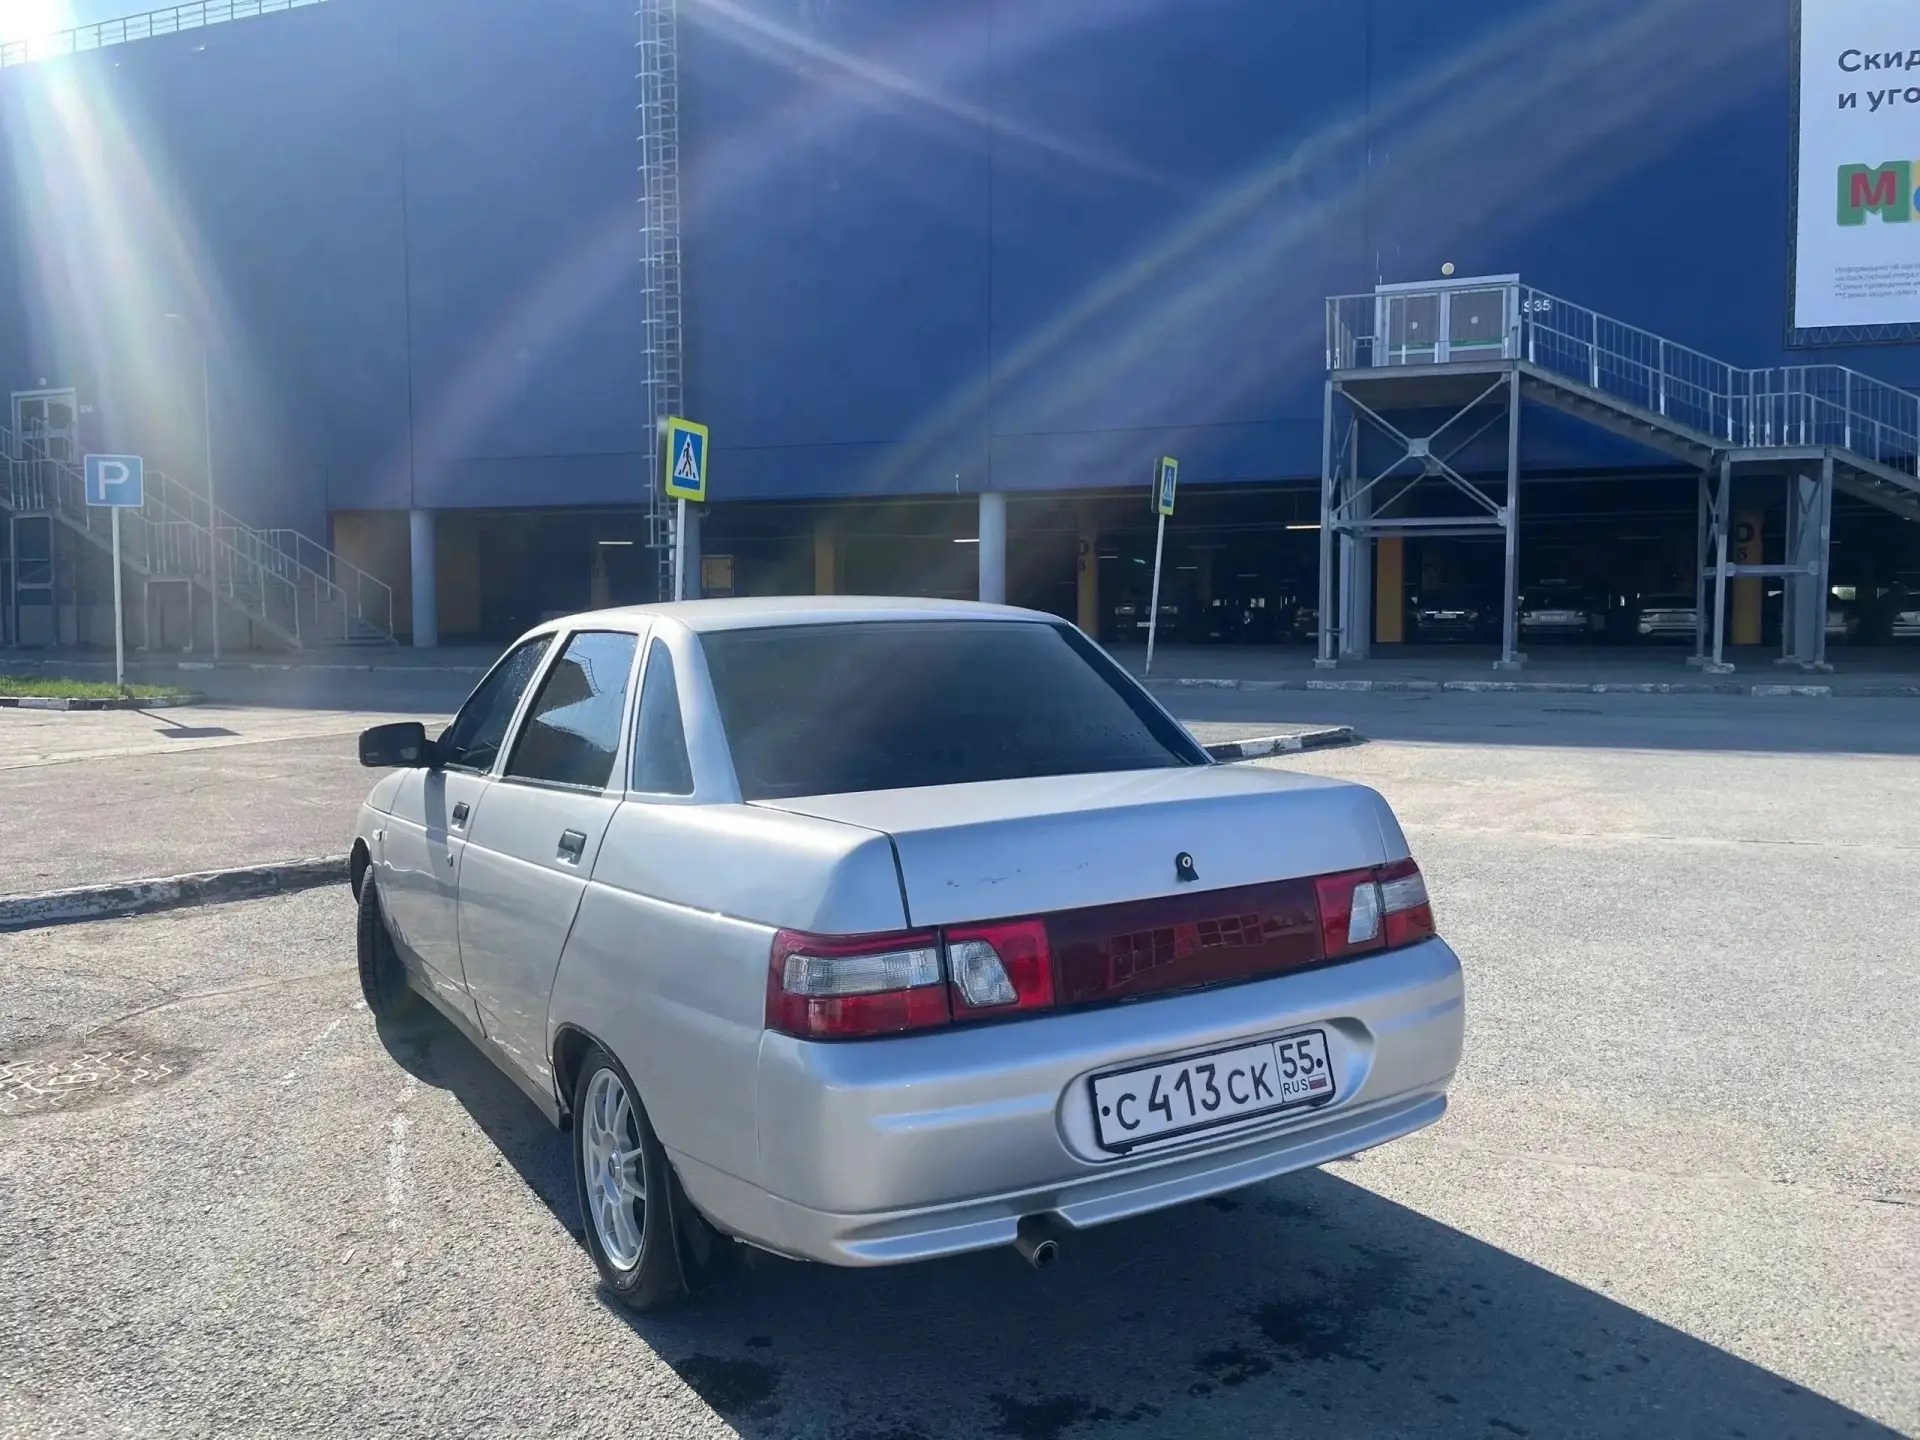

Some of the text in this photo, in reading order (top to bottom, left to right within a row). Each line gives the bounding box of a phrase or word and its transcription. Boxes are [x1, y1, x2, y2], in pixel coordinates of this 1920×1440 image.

[1839, 87, 1920, 113] и уго
[98, 461, 129, 500] P
[1279, 1040, 1315, 1078] 55
[1283, 1079, 1309, 1096] RUS
